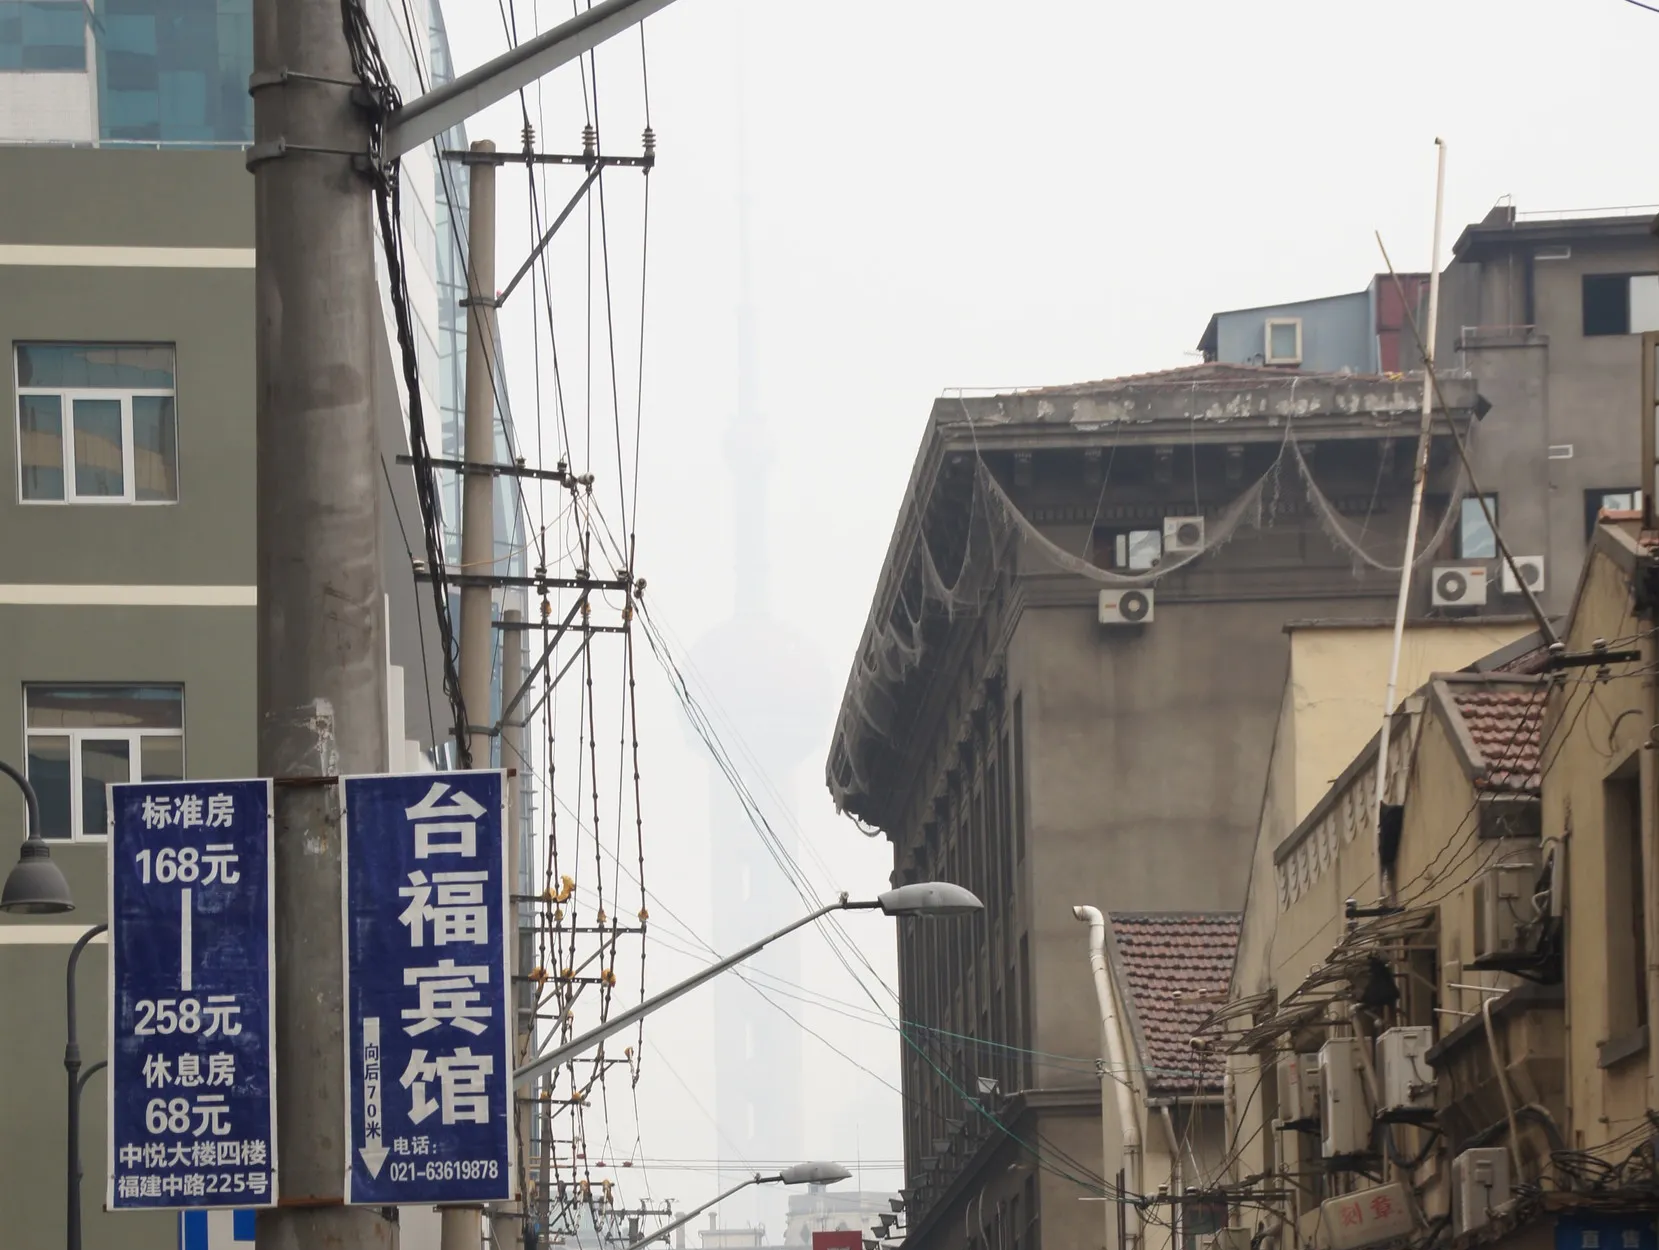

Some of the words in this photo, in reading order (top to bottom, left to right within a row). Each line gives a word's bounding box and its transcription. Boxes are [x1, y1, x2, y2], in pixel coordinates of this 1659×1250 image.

[141, 793, 235, 829] 标准房
[135, 842, 241, 886] 168元
[398, 782, 494, 1126] 台福宾馆
[134, 995, 242, 1037] 258元
[142, 1051, 236, 1089] 休息房
[364, 1043, 381, 1139] 向后70米
[145, 1094, 232, 1137] 68元
[119, 1140, 267, 1169] 中悦大楼四楼
[390, 1160, 499, 1181] 021-63619878
[118, 1173, 269, 1198] 福建中路225号
